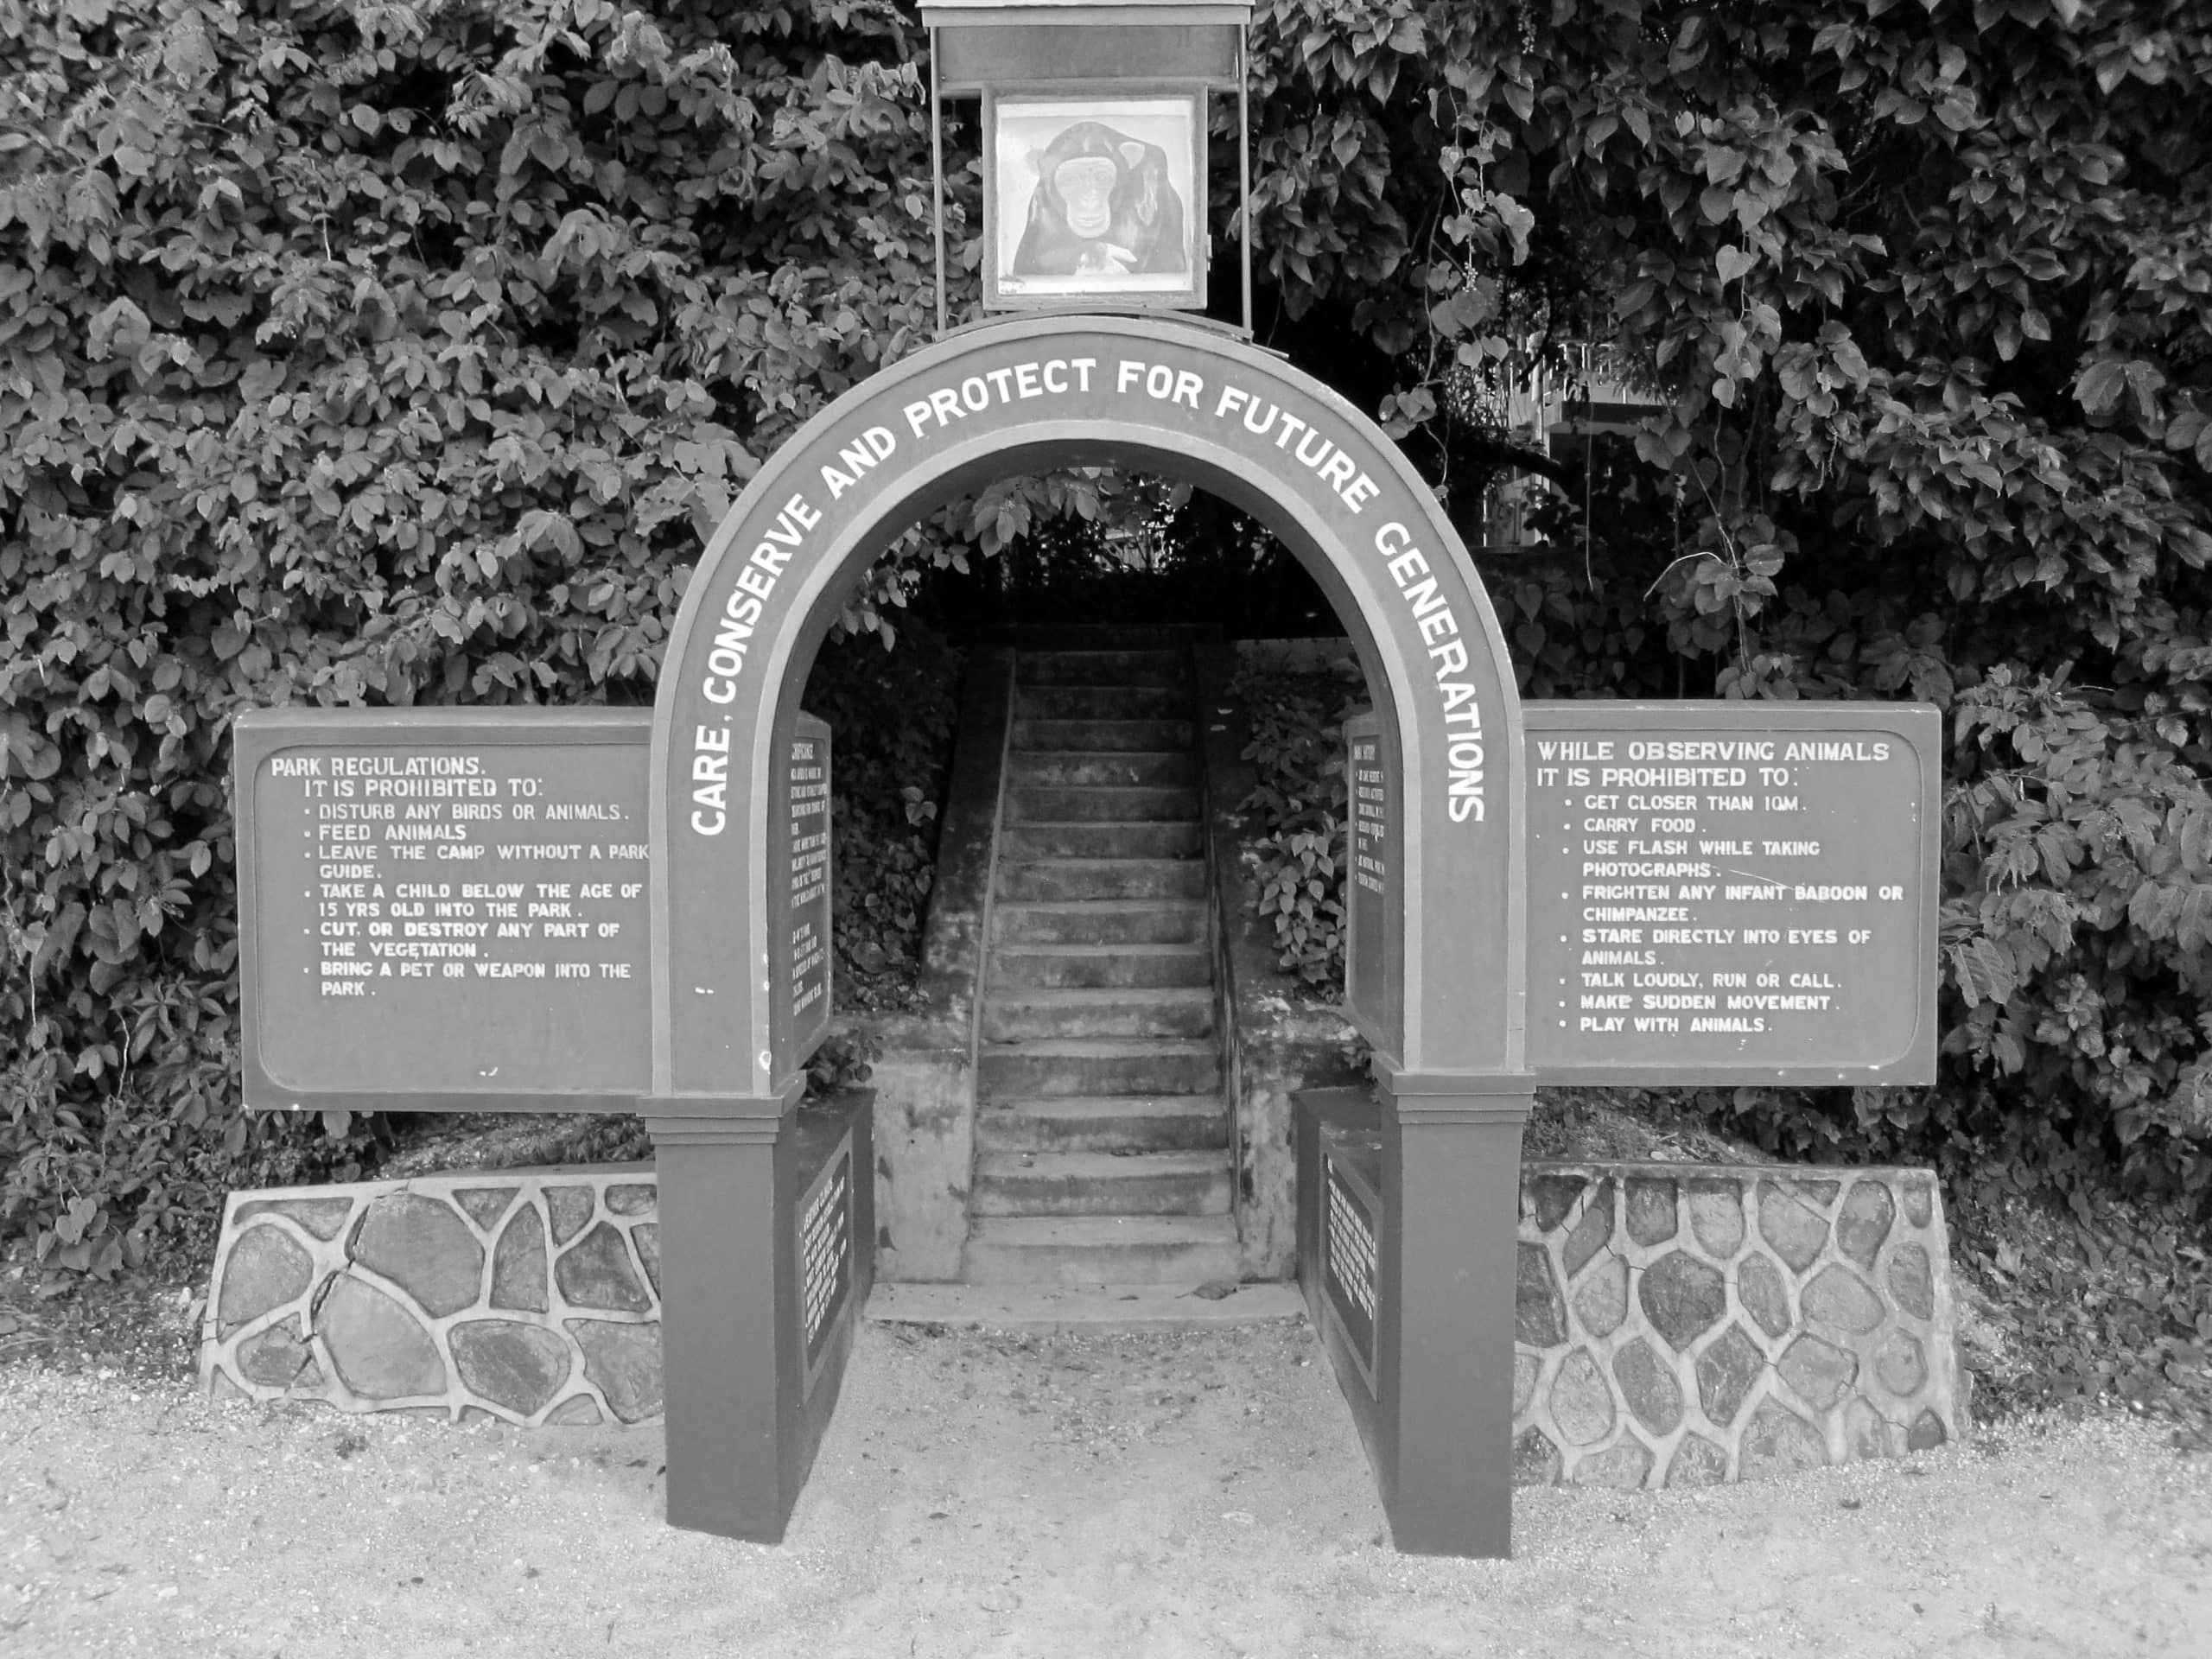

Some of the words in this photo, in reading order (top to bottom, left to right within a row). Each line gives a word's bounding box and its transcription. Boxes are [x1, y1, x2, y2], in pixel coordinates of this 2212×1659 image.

[1117, 360, 1202, 409] FOR
[905, 357, 1097, 439] PROTECT
[1214, 386, 1381, 514] FUTURE
[821, 427, 898, 503] AND
[702, 494, 823, 705] CONSERVE
[1372, 523, 1486, 822] GENERATIONS
[1537, 741, 1614, 760] WHILE
[1629, 741, 1774, 760] OBSERVING
[1783, 742, 1889, 760] ANIMALS
[271, 758, 321, 776] PARK
[331, 757, 486, 776] REGULATIONS.
[692, 715, 731, 835] CARE,
[1537, 768, 1559, 786] IT
[1567, 767, 1590, 786] IS
[1602, 767, 1746, 786] PROHIBITED
[1759, 767, 1797, 786] TO:
[305, 779, 327, 797] IT
[334, 779, 354, 797] IS
[365, 779, 497, 797] PROHIBITED
[508, 779, 543, 797] TO:
[1585, 795, 1619, 810] GET
[1628, 795, 1697, 810] CLOSER
[1707, 796, 1753, 810] THAN
[320, 804, 395, 819] DISTURB
[405, 804, 442, 819] ANY
[453, 804, 502, 819] BIRDS
[512, 804, 535, 820] OR
[319, 824, 370, 841] FEED
[385, 824, 467, 841] ANIMALS
[1584, 817, 1638, 832] CARRY
[319, 845, 378, 860] LEAVE
[391, 845, 426, 860] THE
[437, 845, 485, 859] CAMP
[497, 845, 582, 860] WITHOUT
[589, 845, 601, 859] A
[609, 844, 650, 860] PARK
[1584, 840, 1618, 855] USE
[1628, 840, 1688, 855] FLASH
[1699, 841, 1752, 855] WHILE
[1762, 841, 1820, 855] TAKING
[320, 864, 381, 879] GUIDE.
[320, 884, 365, 898] TAKE
[372, 884, 385, 898] A
[396, 884, 450, 898] CHILD
[462, 883, 524, 898] BELOW
[537, 883, 570, 898] THE
[580, 884, 613, 898] AGE
[620, 884, 642, 898] OF
[1583, 885, 1669, 899] FRIGHTEN
[1679, 885, 1716, 899] ANY
[1726, 885, 1786, 900] INFANT
[1795, 885, 1867, 901] BABOON
[1878, 886, 1903, 900] OR
[320, 902, 338, 917] 15
[346, 902, 380, 917] YRS
[391, 902, 424, 917] OLD
[435, 902, 474, 917] INTO
[486, 903, 518, 918] THE
[369, 922, 393, 936] OR
[404, 922, 488, 937] DESTROY
[497, 923, 533, 938] ANY
[544, 923, 588, 938] PART
[598, 923, 620, 938] OF
[1583, 928, 1643, 944] STARE
[1653, 929, 1735, 944] DIRECTLY
[1744, 930, 1780, 944] INTO
[1789, 930, 1837, 944] EYES
[1848, 930, 1872, 944] OF
[321, 942, 355, 957] THE
[321, 961, 373, 976] BRING
[379, 962, 391, 976] A
[401, 963, 434, 977] PET
[443, 963, 464, 977] OR
[474, 963, 545, 977] WEAPON
[556, 963, 590, 977] INTO
[599, 963, 631, 978] THE
[1581, 972, 1624, 987] TALK
[1633, 973, 1703, 988] LOUDLY,
[1713, 973, 1746, 988] RUN
[1757, 974, 1780, 988] OR
[1789, 973, 1841, 988] CALL.
[1580, 995, 1632, 1009] MAKE
[1643, 995, 1715, 1009] SUDDEN
[1580, 1017, 1625, 1032] PLAY
[1634, 1017, 1679, 1032] WITH
